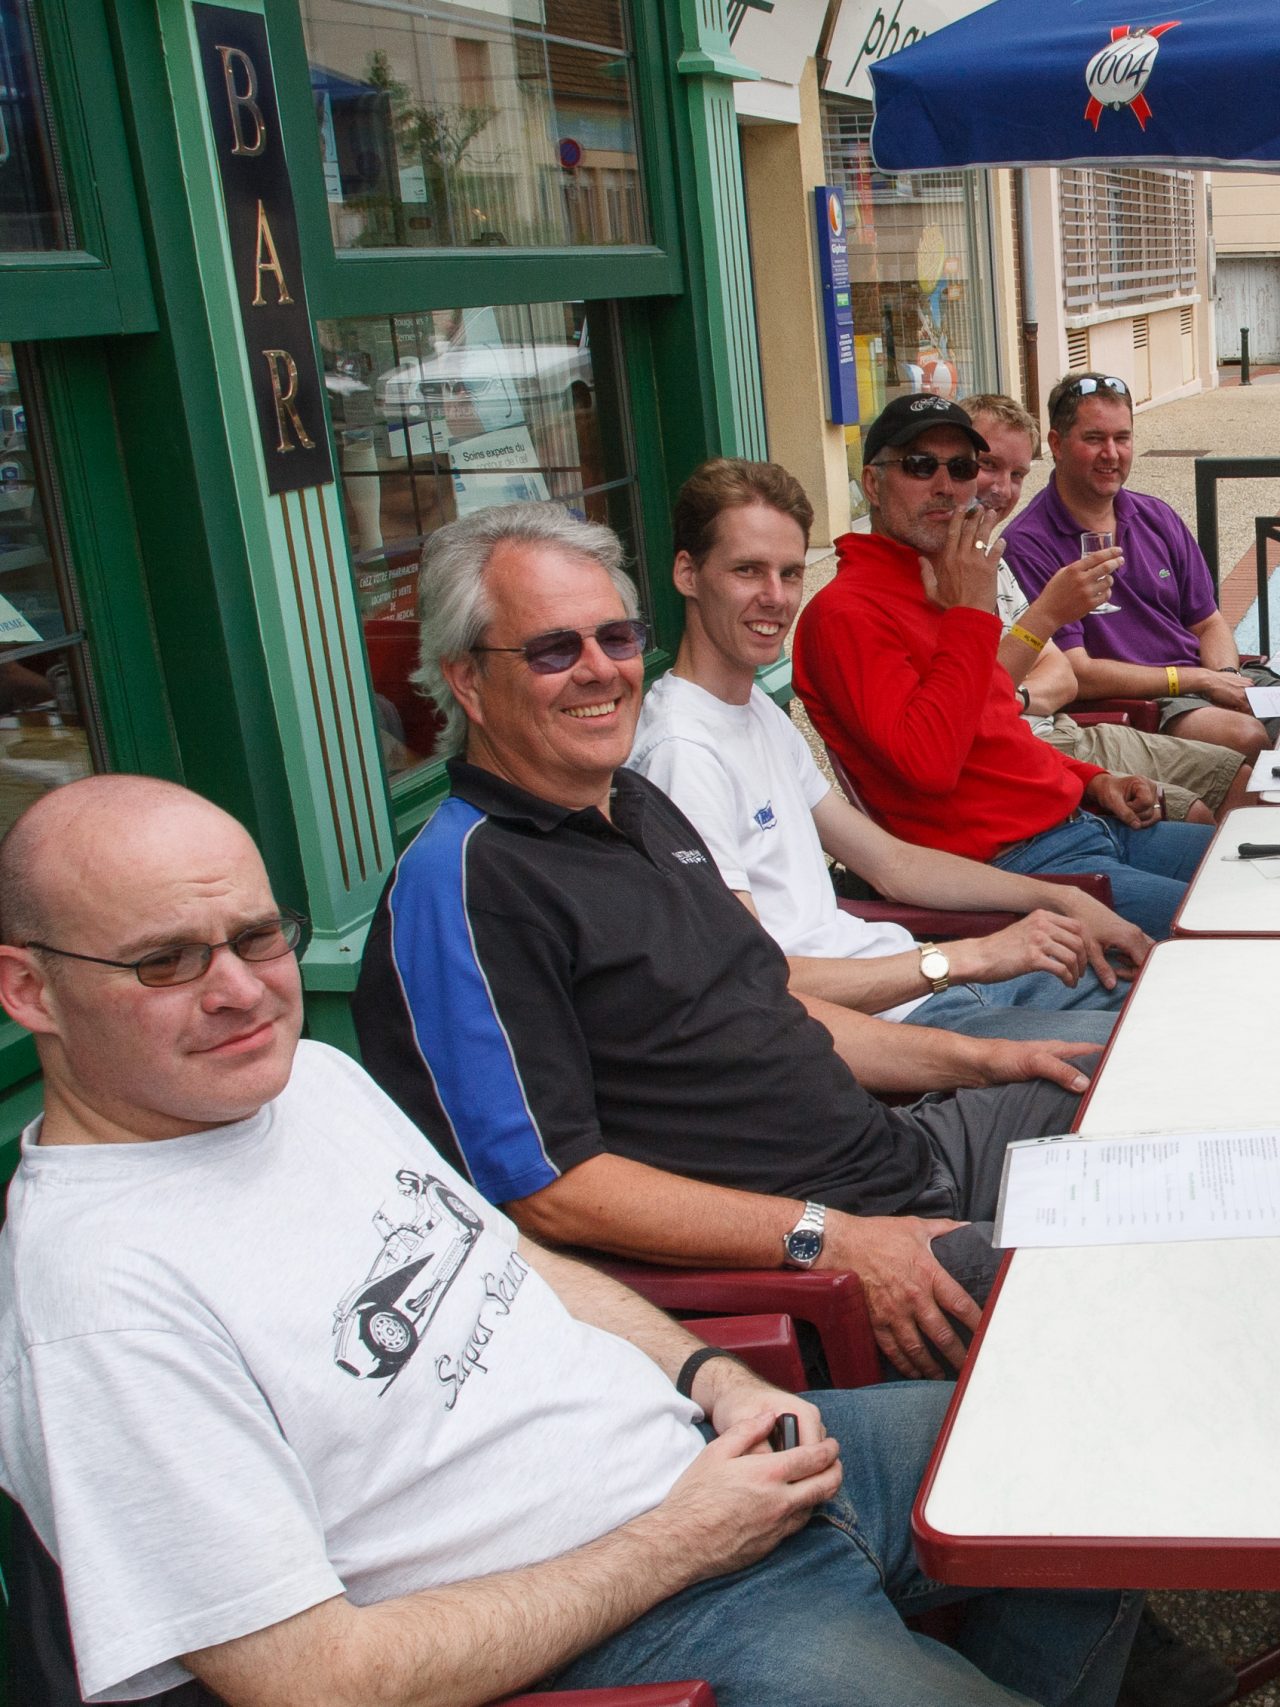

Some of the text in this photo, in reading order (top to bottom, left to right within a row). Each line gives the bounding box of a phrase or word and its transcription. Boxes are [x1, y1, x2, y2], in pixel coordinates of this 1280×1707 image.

[846, 0, 929, 87] pha
[214, 44, 316, 454] BAR
[462, 442, 526, 462] Soins experts du
[434, 1314, 494, 1411] Super
